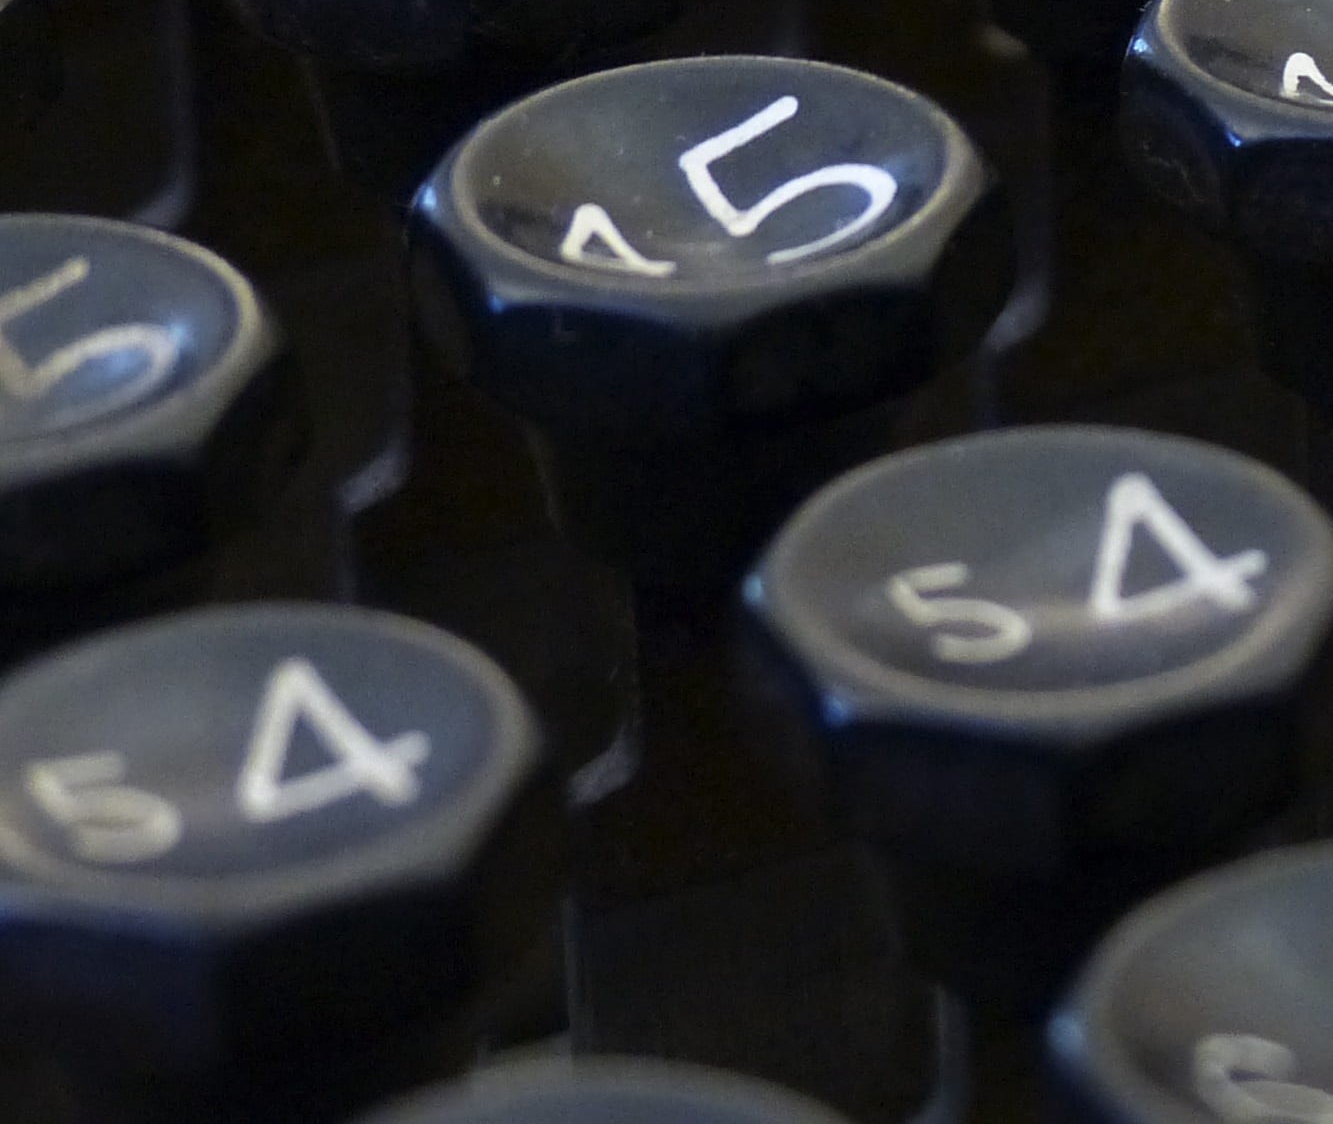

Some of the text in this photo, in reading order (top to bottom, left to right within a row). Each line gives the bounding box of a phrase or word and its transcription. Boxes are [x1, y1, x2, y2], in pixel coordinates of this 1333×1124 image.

[678, 95, 898, 267] 5
[887, 473, 1268, 663] 5 4
[26, 654, 432, 863] 5 4
